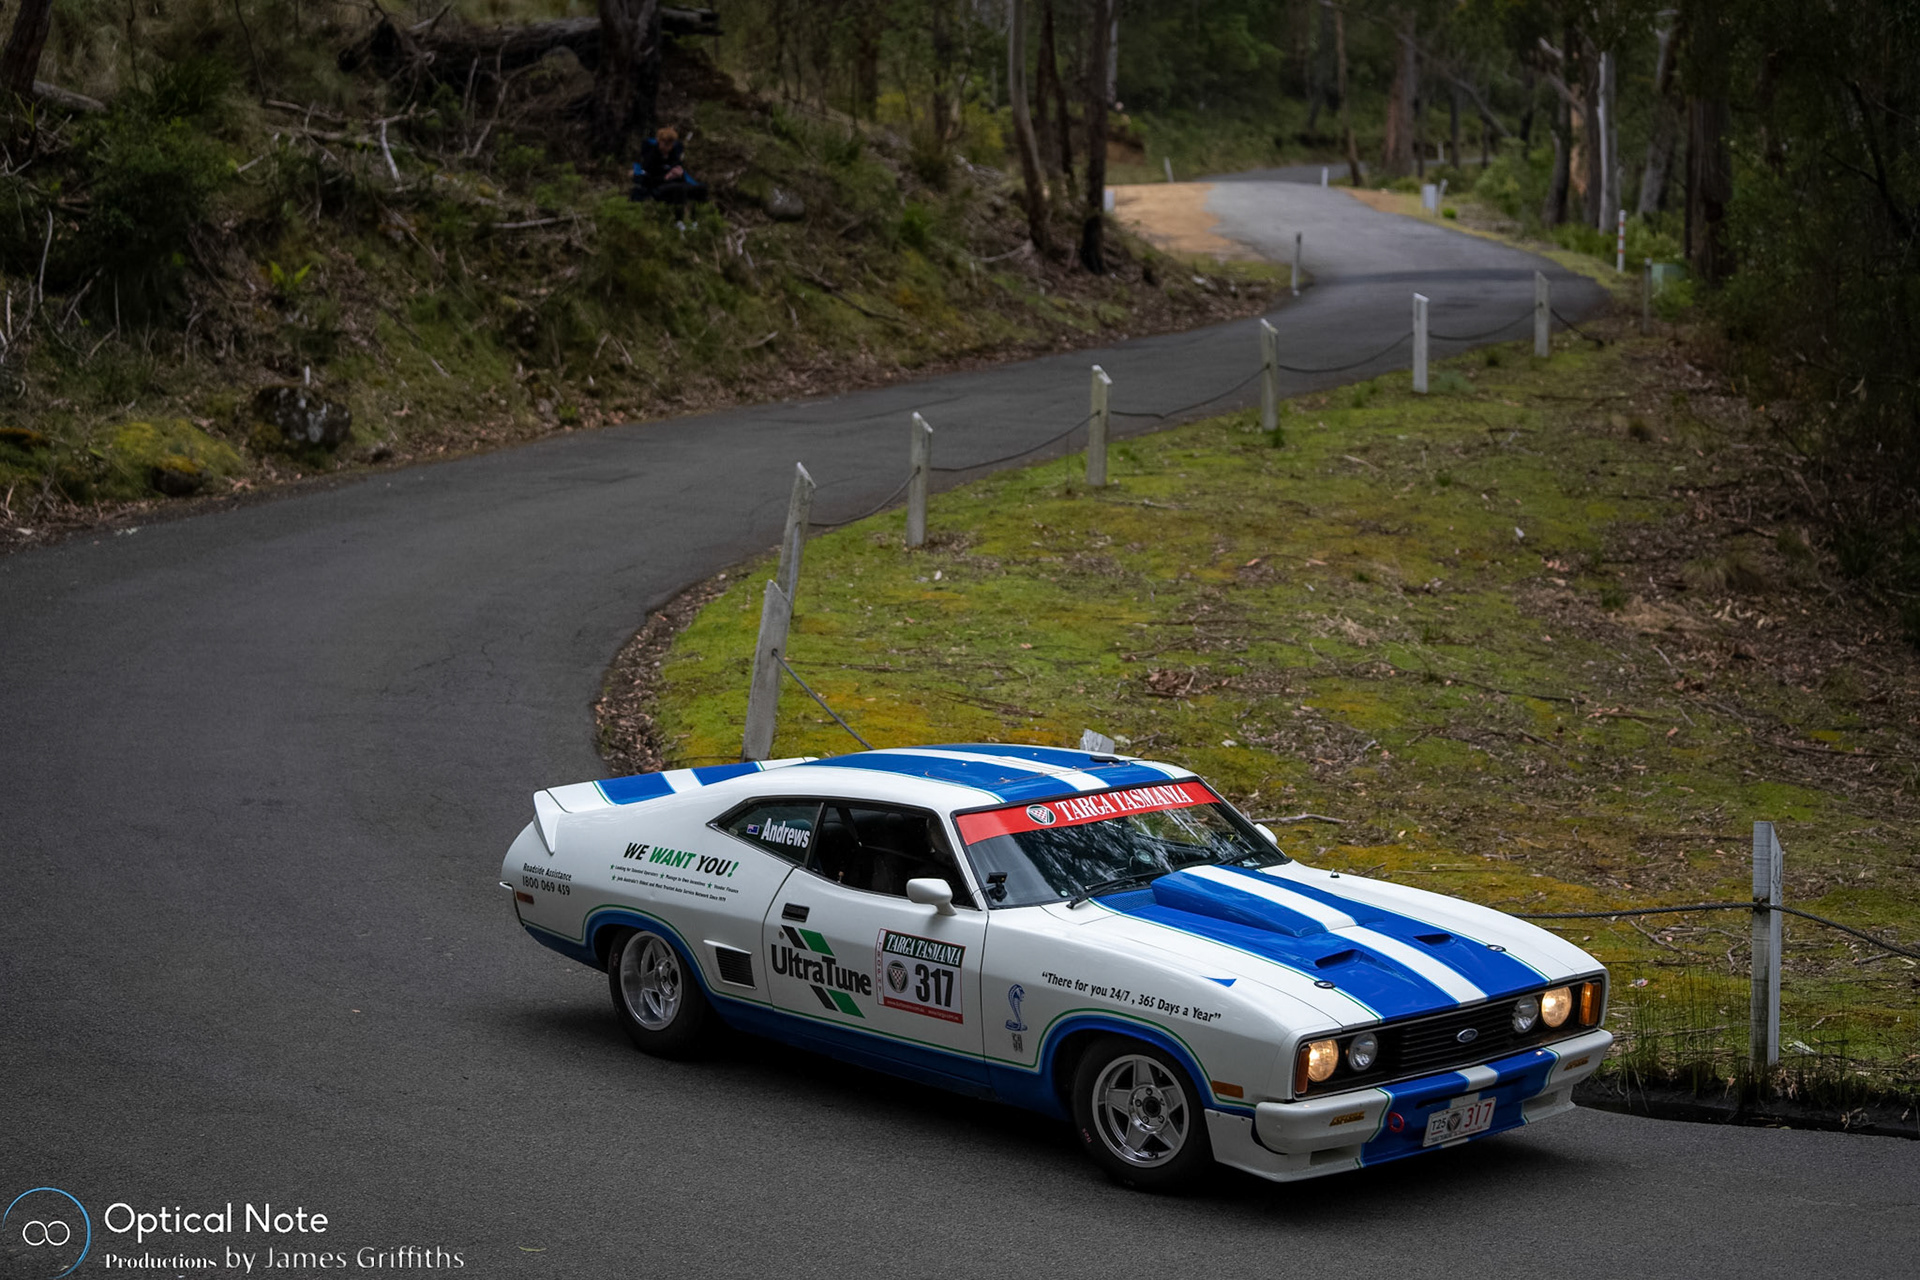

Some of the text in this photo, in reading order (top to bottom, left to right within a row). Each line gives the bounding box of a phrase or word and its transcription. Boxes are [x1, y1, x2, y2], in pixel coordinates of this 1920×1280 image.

[1055, 784, 1194, 821] TARGA TASMANIA
[760, 817, 811, 848] Andrews
[522, 862, 572, 881] Roadside Assistance
[623, 842, 739, 878] WE WANT YOU!
[522, 875, 571, 896] 1800 069 459
[886, 933, 962, 966] TARGA TASMANIA
[770, 943, 872, 996] UltraTune
[915, 963, 954, 1008] 317
[1074, 979, 1089, 992] for
[1091, 984, 1108, 997] you
[1109, 987, 1130, 1002] 24/7
[1138, 994, 1155, 1008] 365
[1157, 998, 1180, 1016] Days
[1182, 1006, 1189, 1016] a
[1432, 1117, 1447, 1131] T25
[1464, 1102, 1493, 1128] 317
